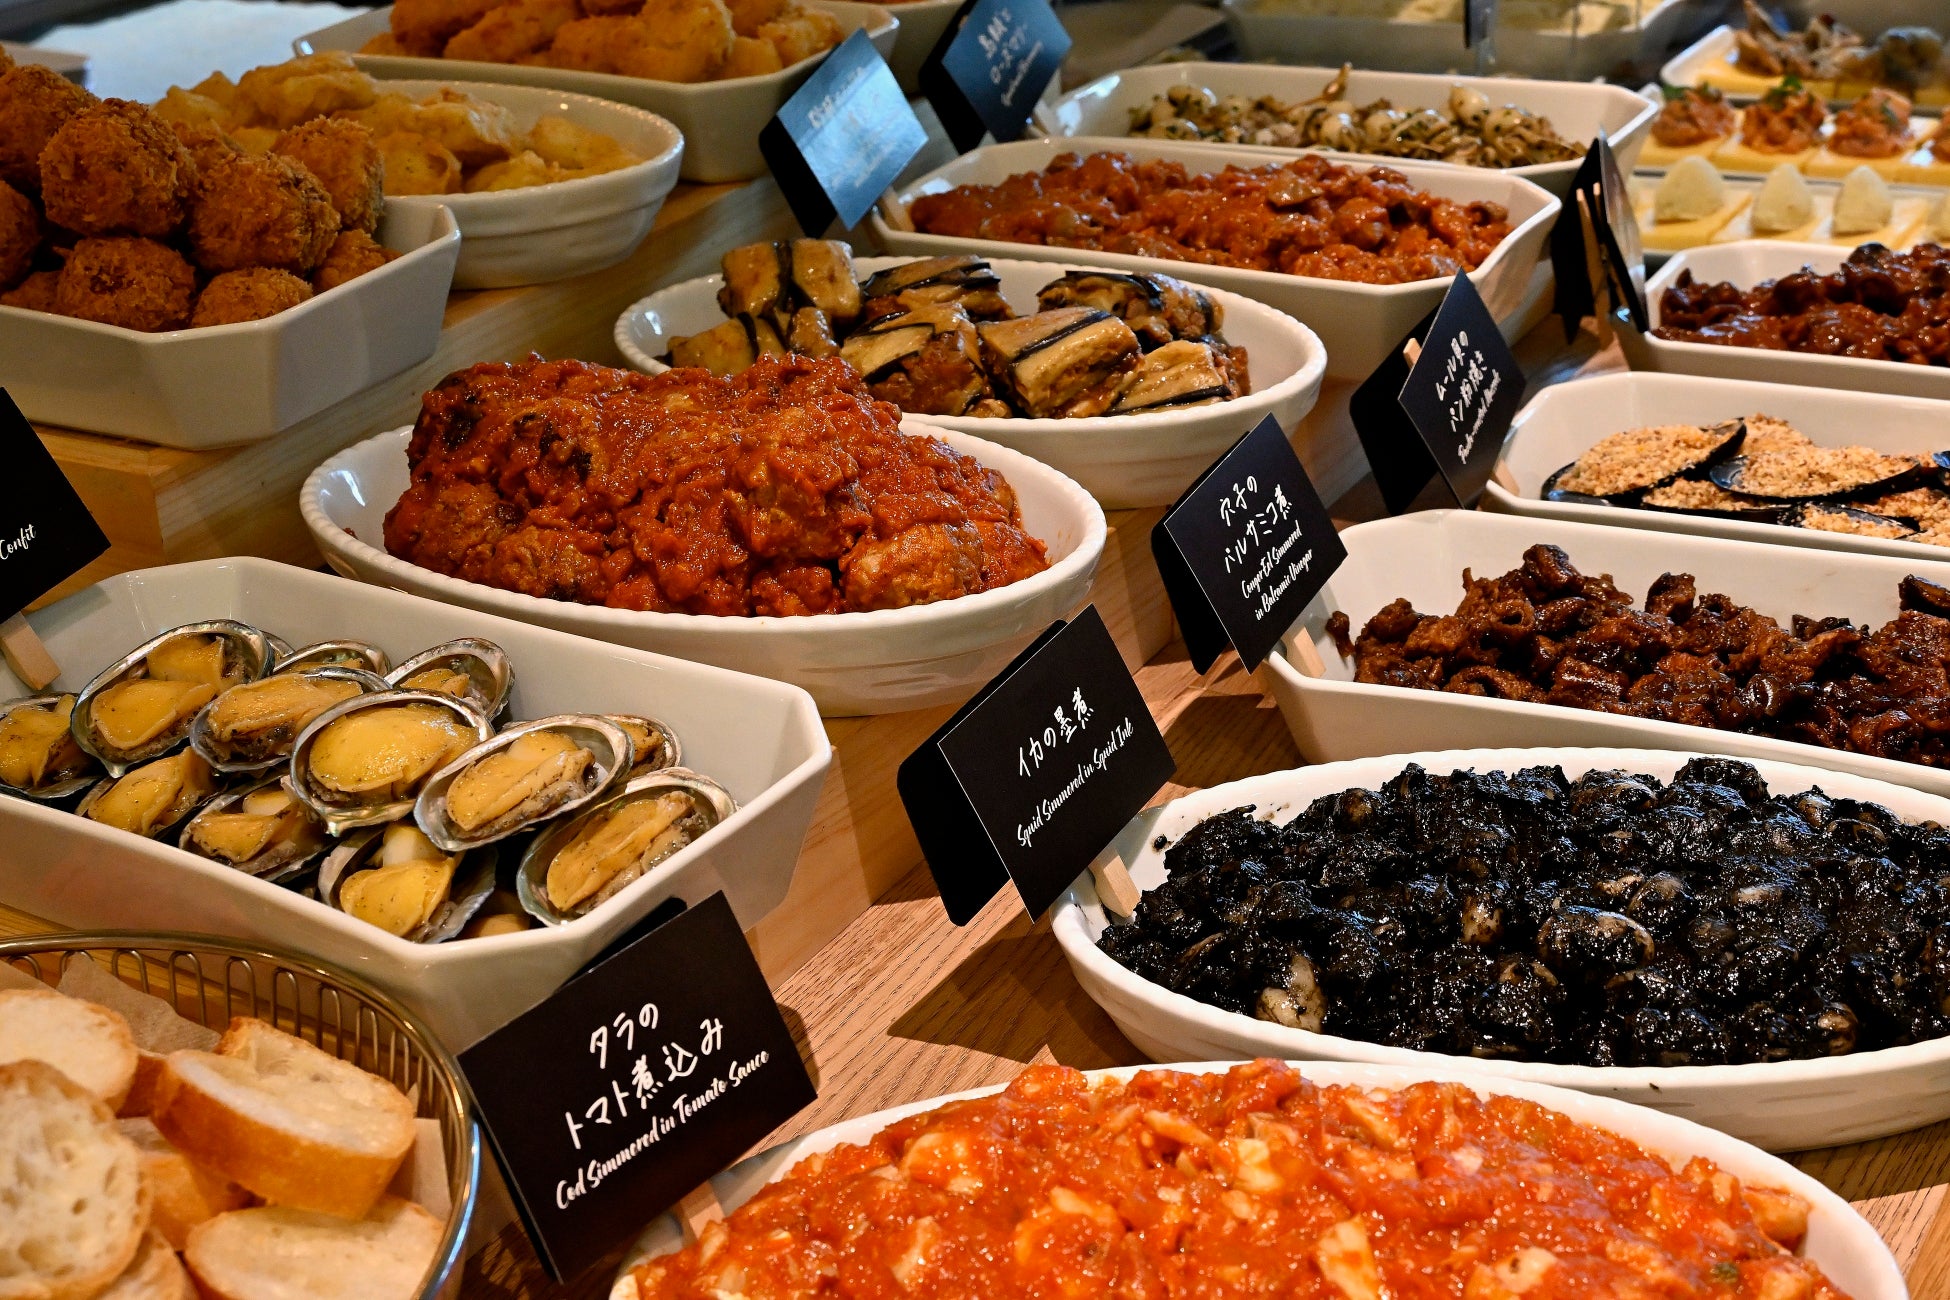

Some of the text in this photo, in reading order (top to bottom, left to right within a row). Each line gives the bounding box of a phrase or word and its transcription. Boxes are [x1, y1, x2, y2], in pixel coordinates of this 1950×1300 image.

[1219, 475, 1258, 527] 穴子の
[0, 523, 37, 560] Confit
[1241, 520, 1303, 599] Conger Eel Simmered
[1255, 548, 1313, 621] in Balsamic Vinegar
[1018, 686, 1094, 778] イカの墨煮
[1017, 717, 1134, 848] Squid Simmered in Squid Ink
[589, 1002, 659, 1070] タラの
[565, 1017, 724, 1150] トマト煮込み
[555, 1050, 770, 1210] Cod Simmered in Tomato Sauce
